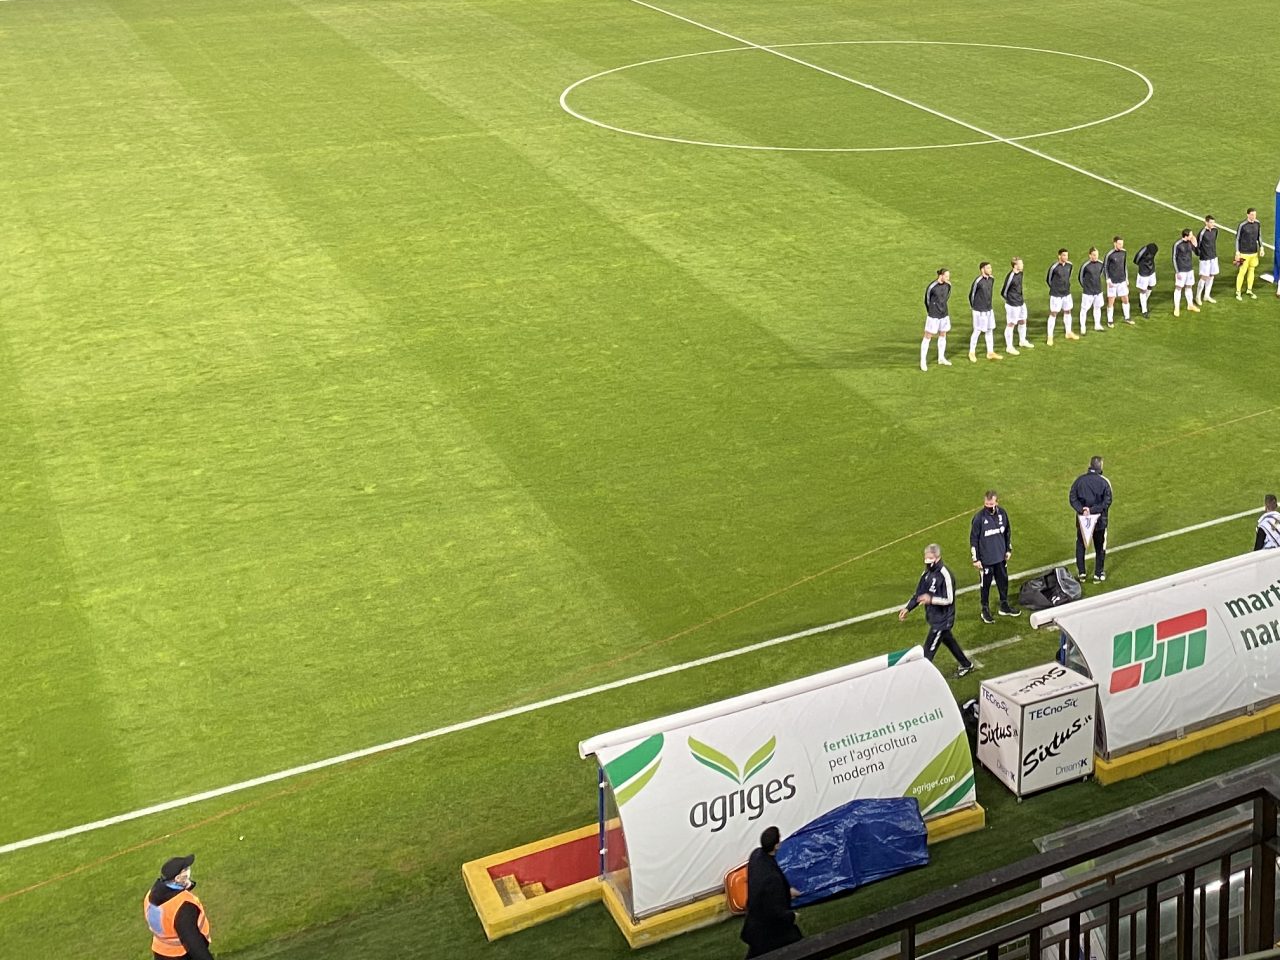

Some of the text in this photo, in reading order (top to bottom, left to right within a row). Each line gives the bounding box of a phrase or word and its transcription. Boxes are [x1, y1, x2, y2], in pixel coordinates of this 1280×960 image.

[823, 707, 944, 753] fertilizzanti speciali
[828, 734, 918, 772] per l'agricoltura
[832, 760, 885, 785] moderna
[689, 773, 797, 833] agriges
